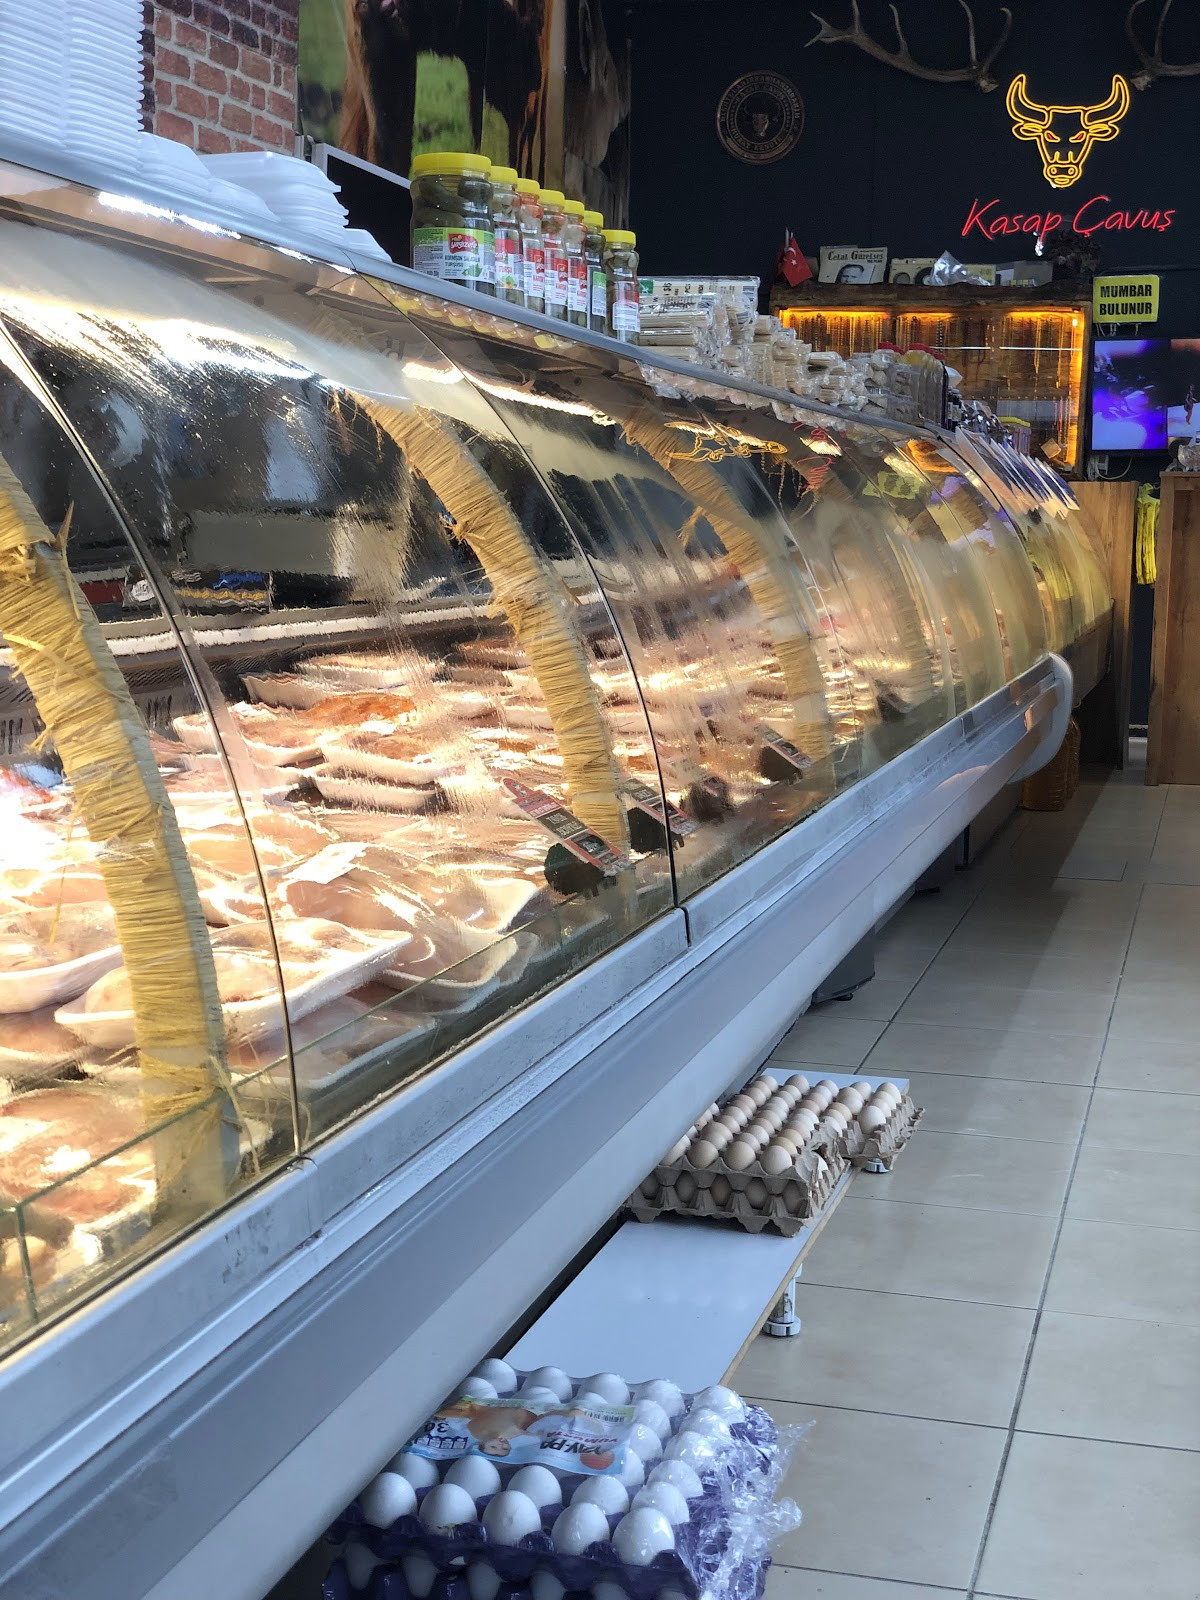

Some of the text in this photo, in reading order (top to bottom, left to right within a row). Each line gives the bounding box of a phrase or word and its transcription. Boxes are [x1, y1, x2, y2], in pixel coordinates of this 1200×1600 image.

[960, 195, 1176, 244] Kasap Çavuş
[1100, 284, 1153, 299] MUMBAR
[1099, 302, 1153, 316] BULUNUR
